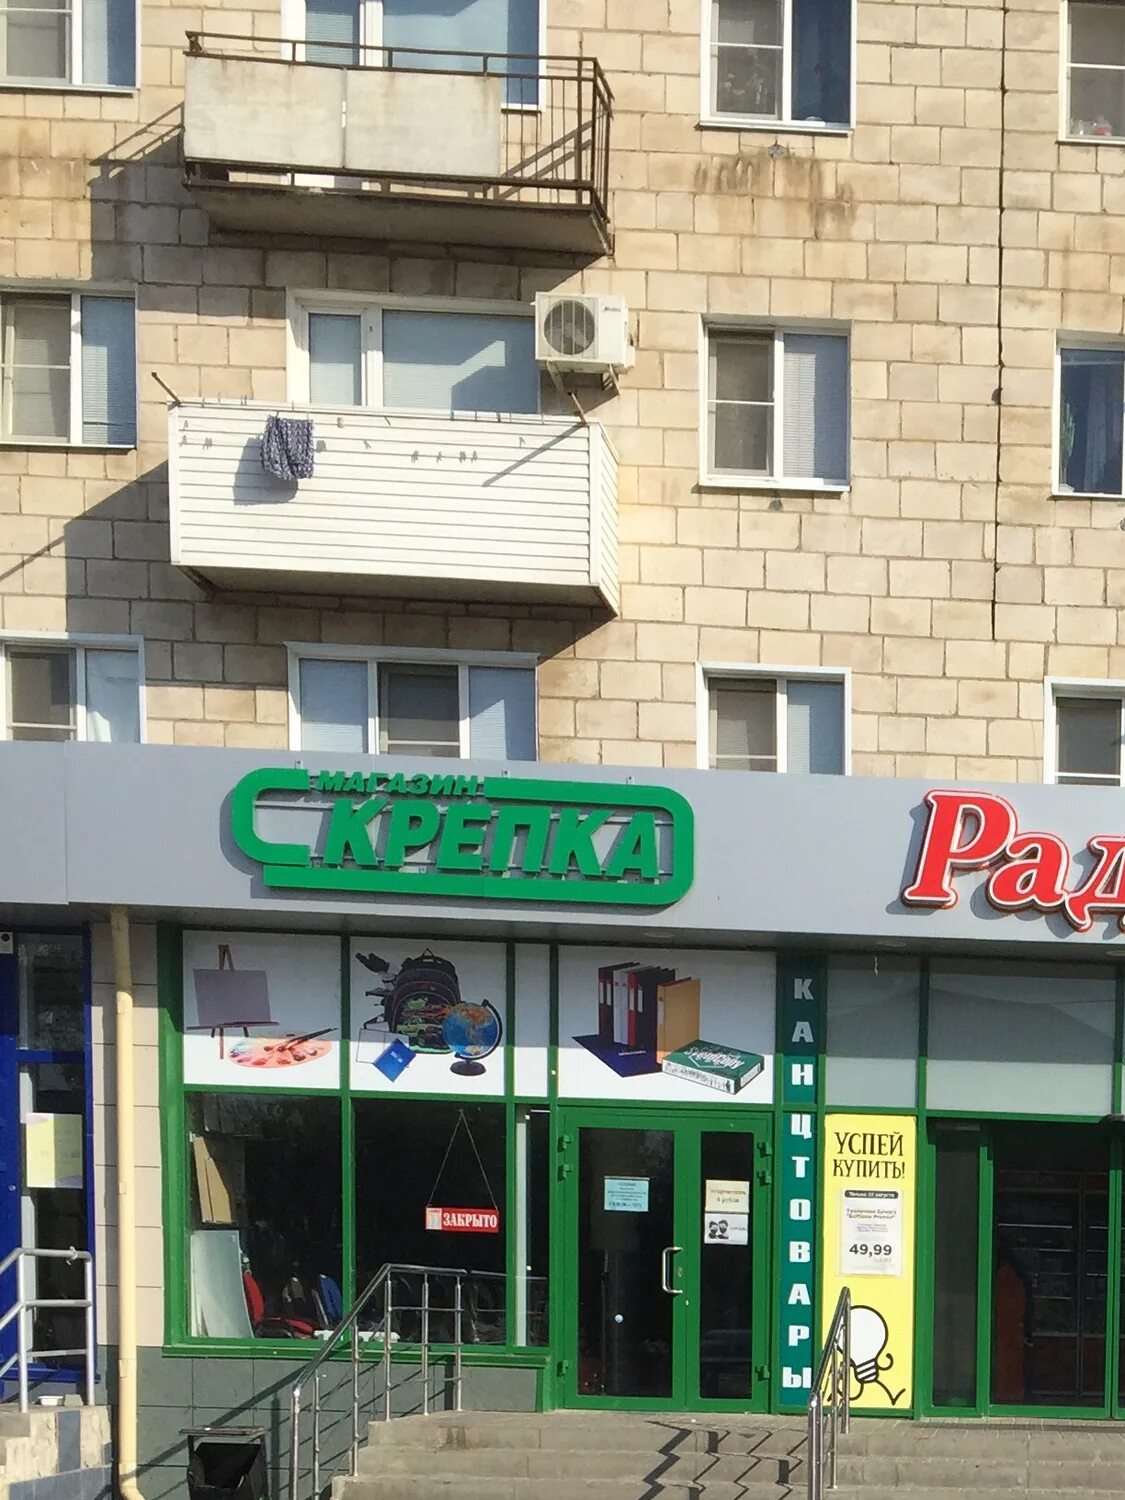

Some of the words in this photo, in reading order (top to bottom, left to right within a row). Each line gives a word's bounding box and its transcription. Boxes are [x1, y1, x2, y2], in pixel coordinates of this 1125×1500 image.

[316, 770, 479, 797] МАГАЗИН
[834, 1131, 904, 1157] УСПЕЙ
[833, 1158, 906, 1180] КУПИТЬ!
[782, 978, 814, 1389] КАНЦТОВАРЫ
[443, 1212, 498, 1228] ЗАКРЫТО
[849, 1244, 892, 1257] 49,99
